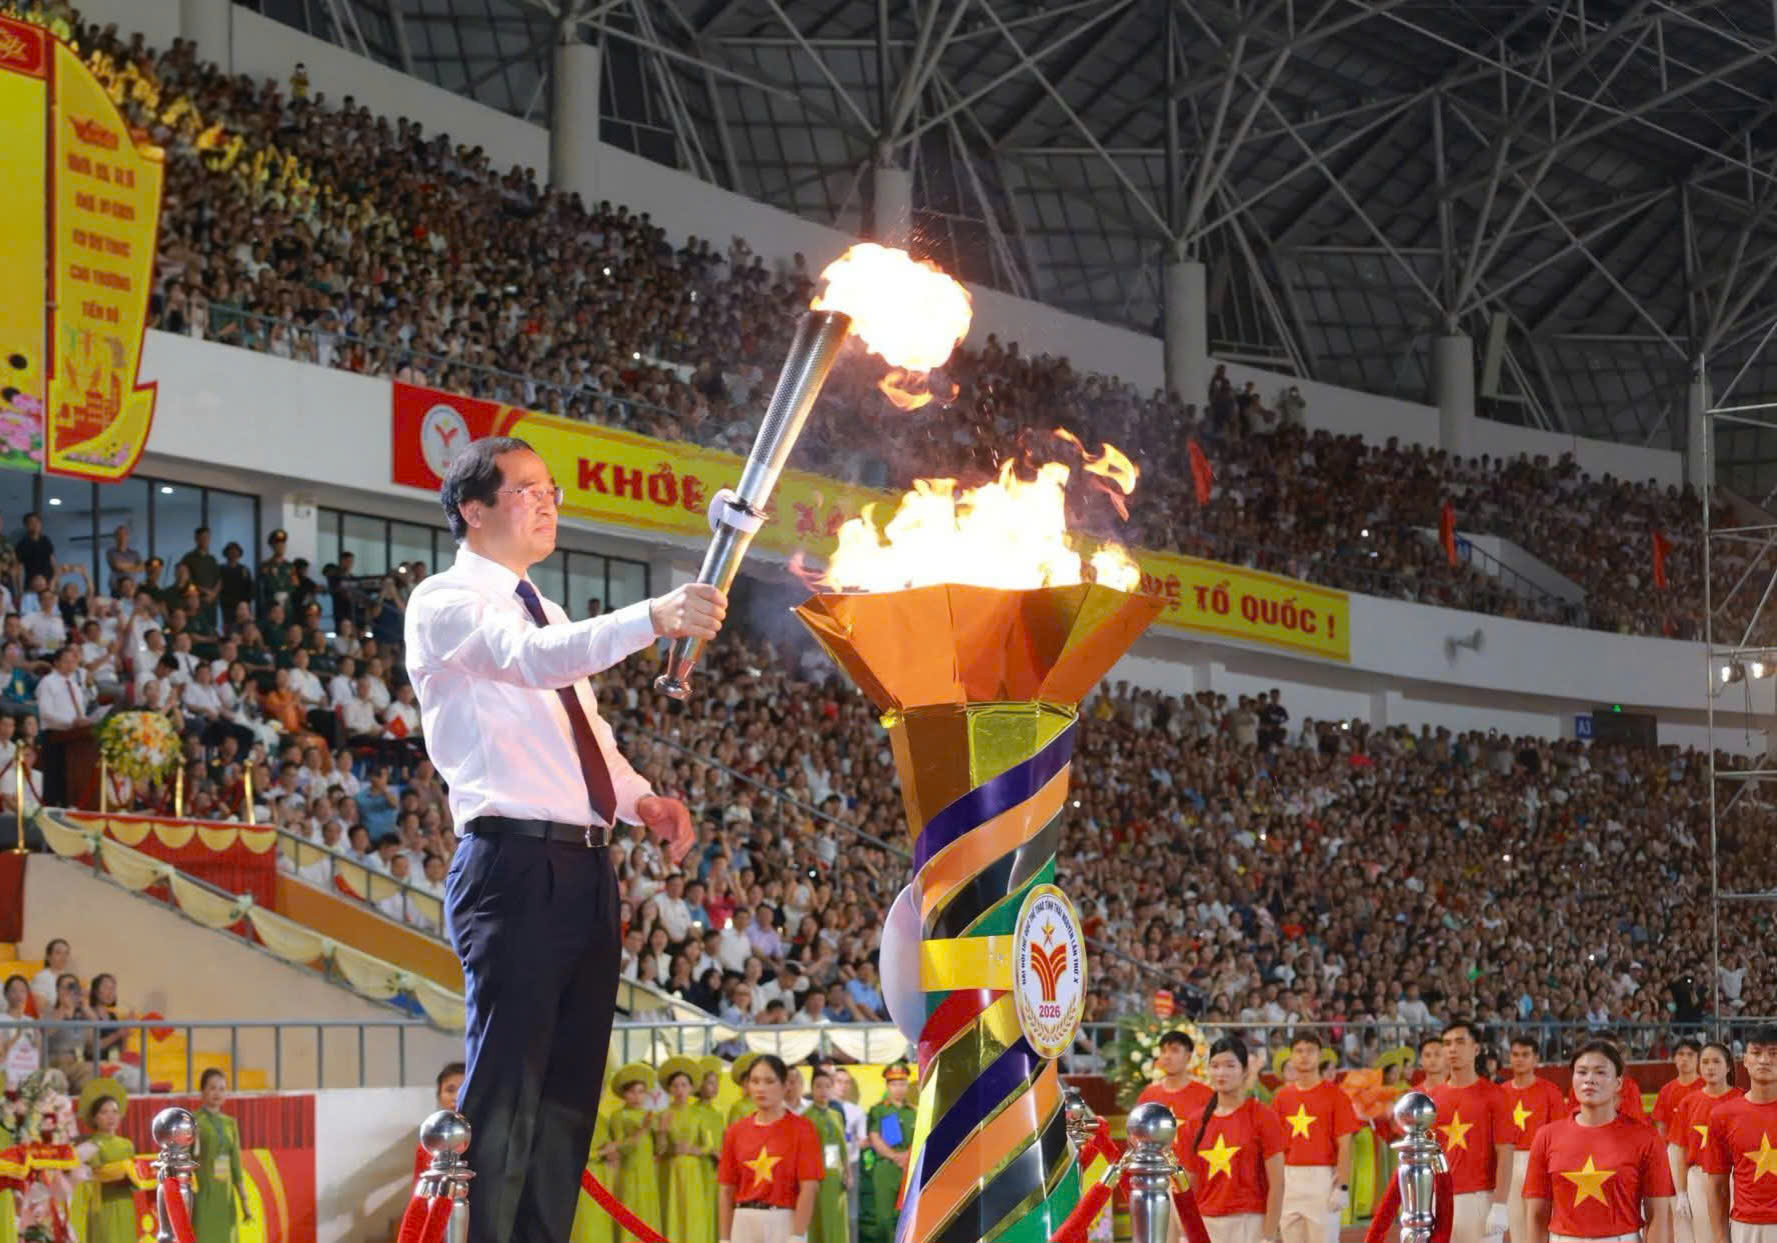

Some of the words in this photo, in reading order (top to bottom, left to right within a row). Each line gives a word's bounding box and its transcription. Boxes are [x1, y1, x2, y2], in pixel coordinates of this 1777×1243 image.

[1192, 579, 1230, 616] TỔ
[1241, 597, 1317, 634] QUỐC
[1038, 1005, 1061, 1019] 2026
